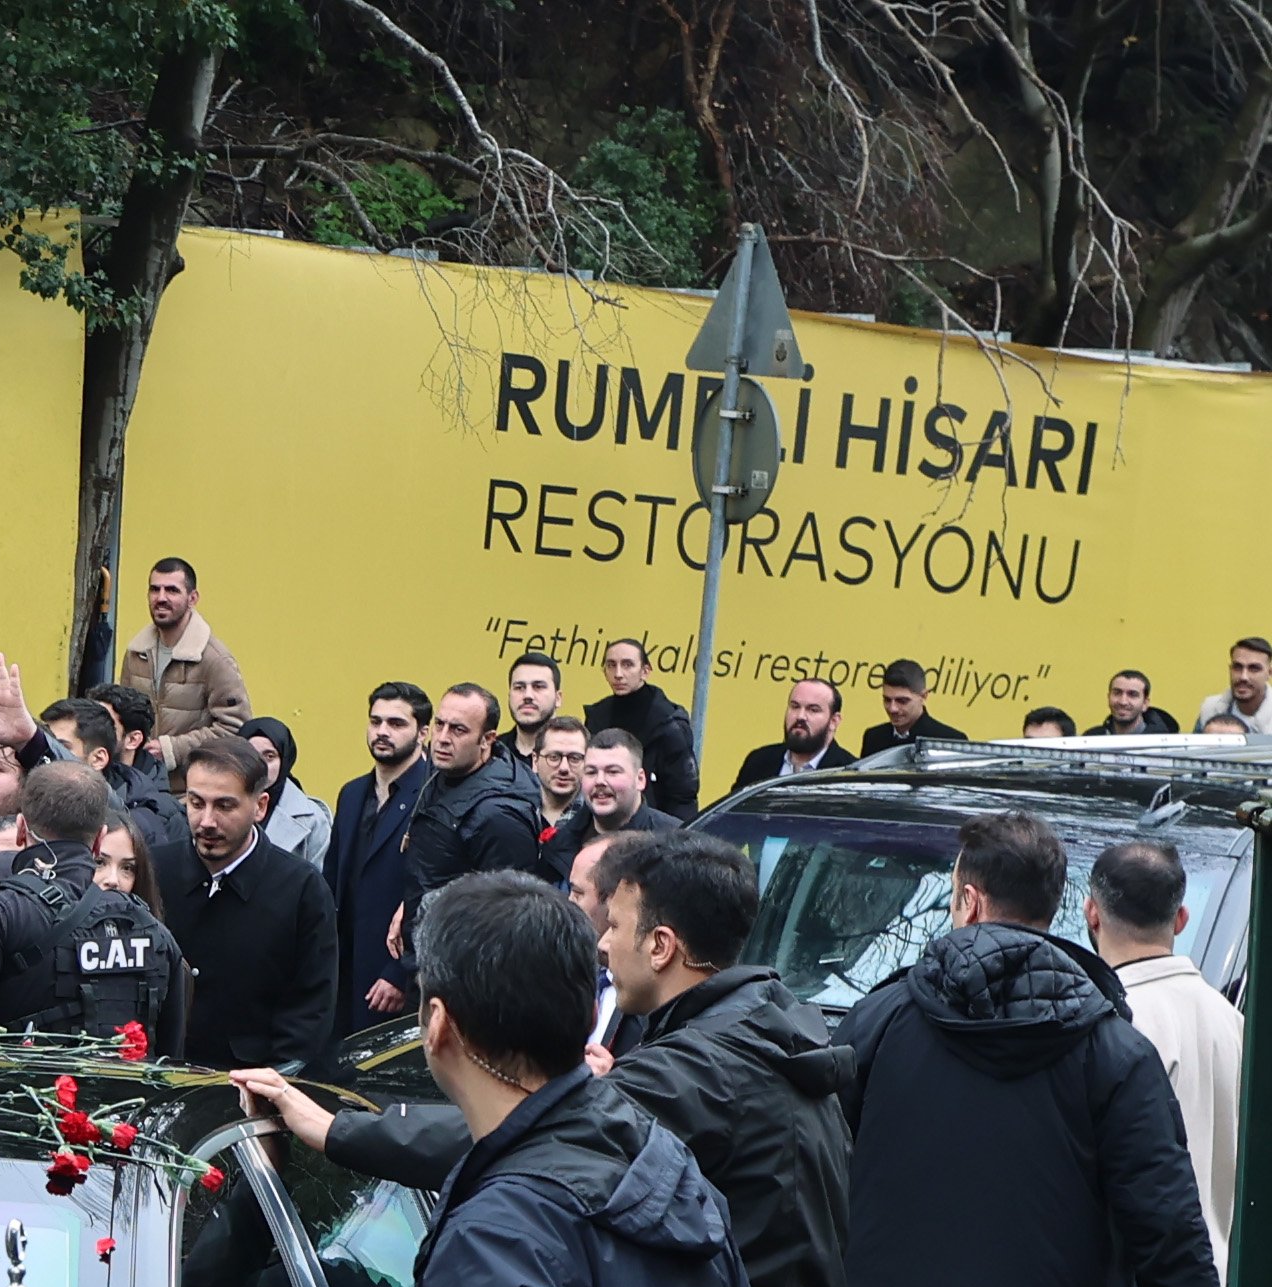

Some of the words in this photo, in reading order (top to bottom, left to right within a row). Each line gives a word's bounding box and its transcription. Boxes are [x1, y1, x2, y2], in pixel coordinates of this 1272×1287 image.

[495, 352, 815, 464] RUMİ
[835, 375, 1098, 496] HİSARI
[483, 478, 1081, 605] RESTORASYONU
[485, 616, 615, 667] "Fethi
[642, 630, 746, 679] kalsi
[80, 937, 151, 971] C.A.T
